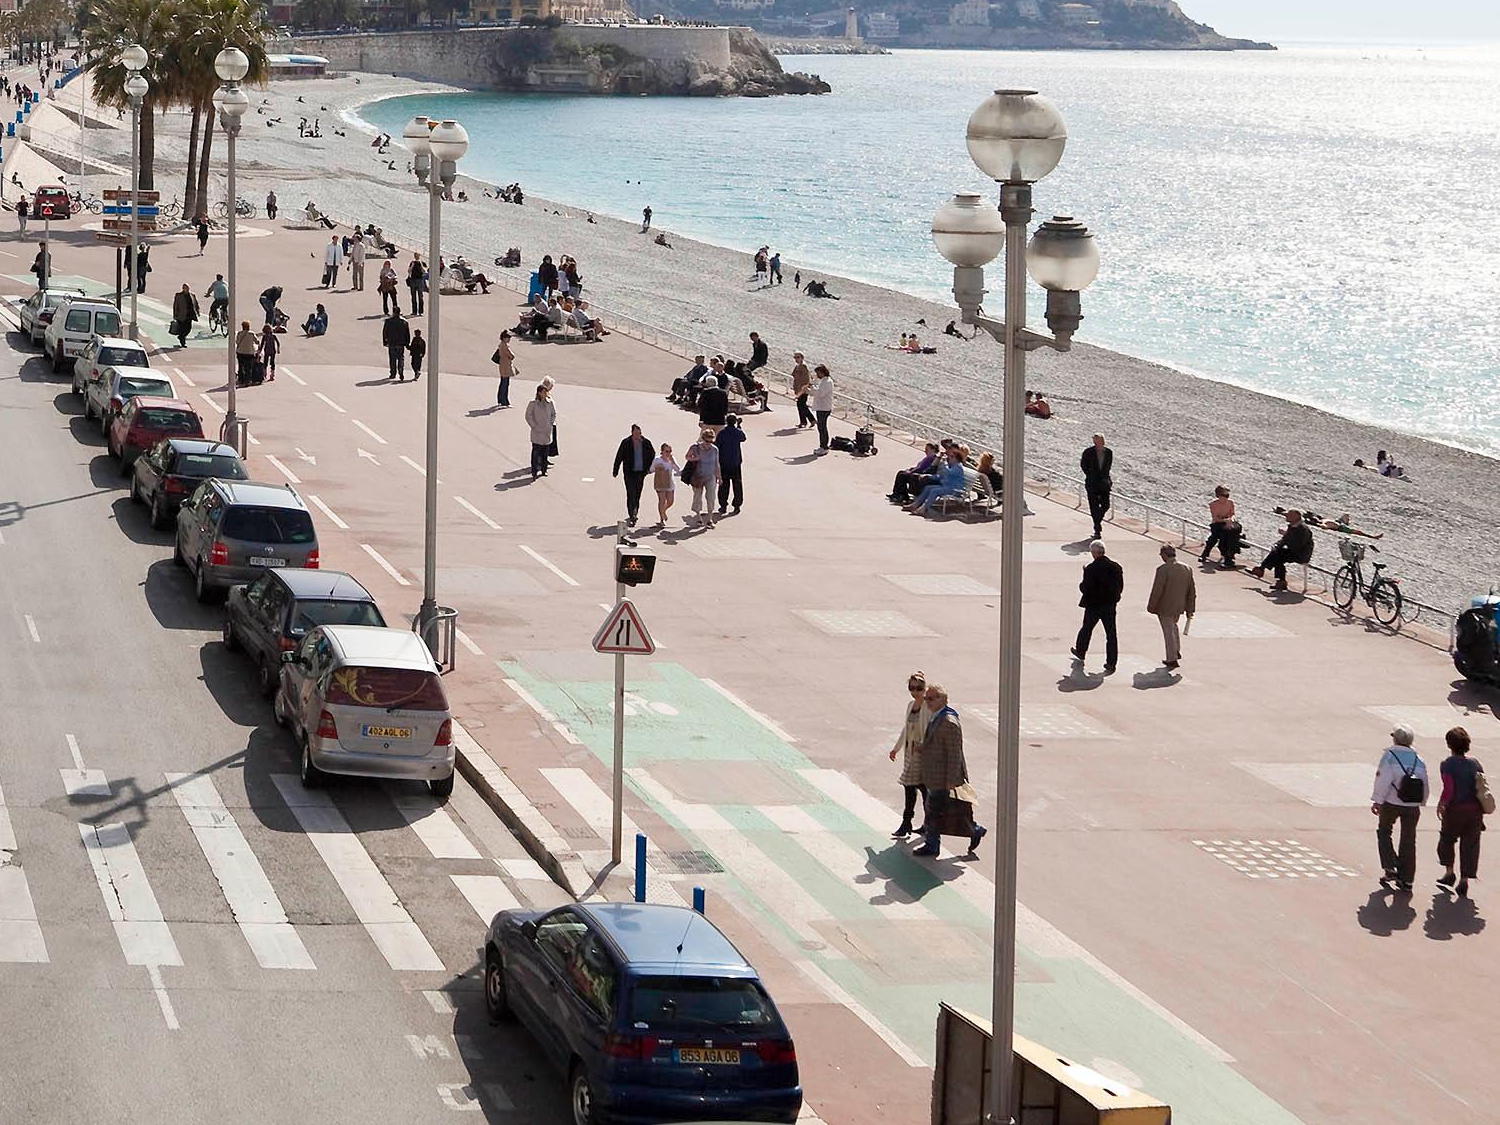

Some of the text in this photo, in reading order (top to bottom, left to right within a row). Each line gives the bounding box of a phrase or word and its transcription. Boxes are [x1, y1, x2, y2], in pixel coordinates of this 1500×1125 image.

[369, 727, 383, 736] 402
[399, 729, 409, 738] 06
[680, 1050, 739, 1063] 853 AGA 06
